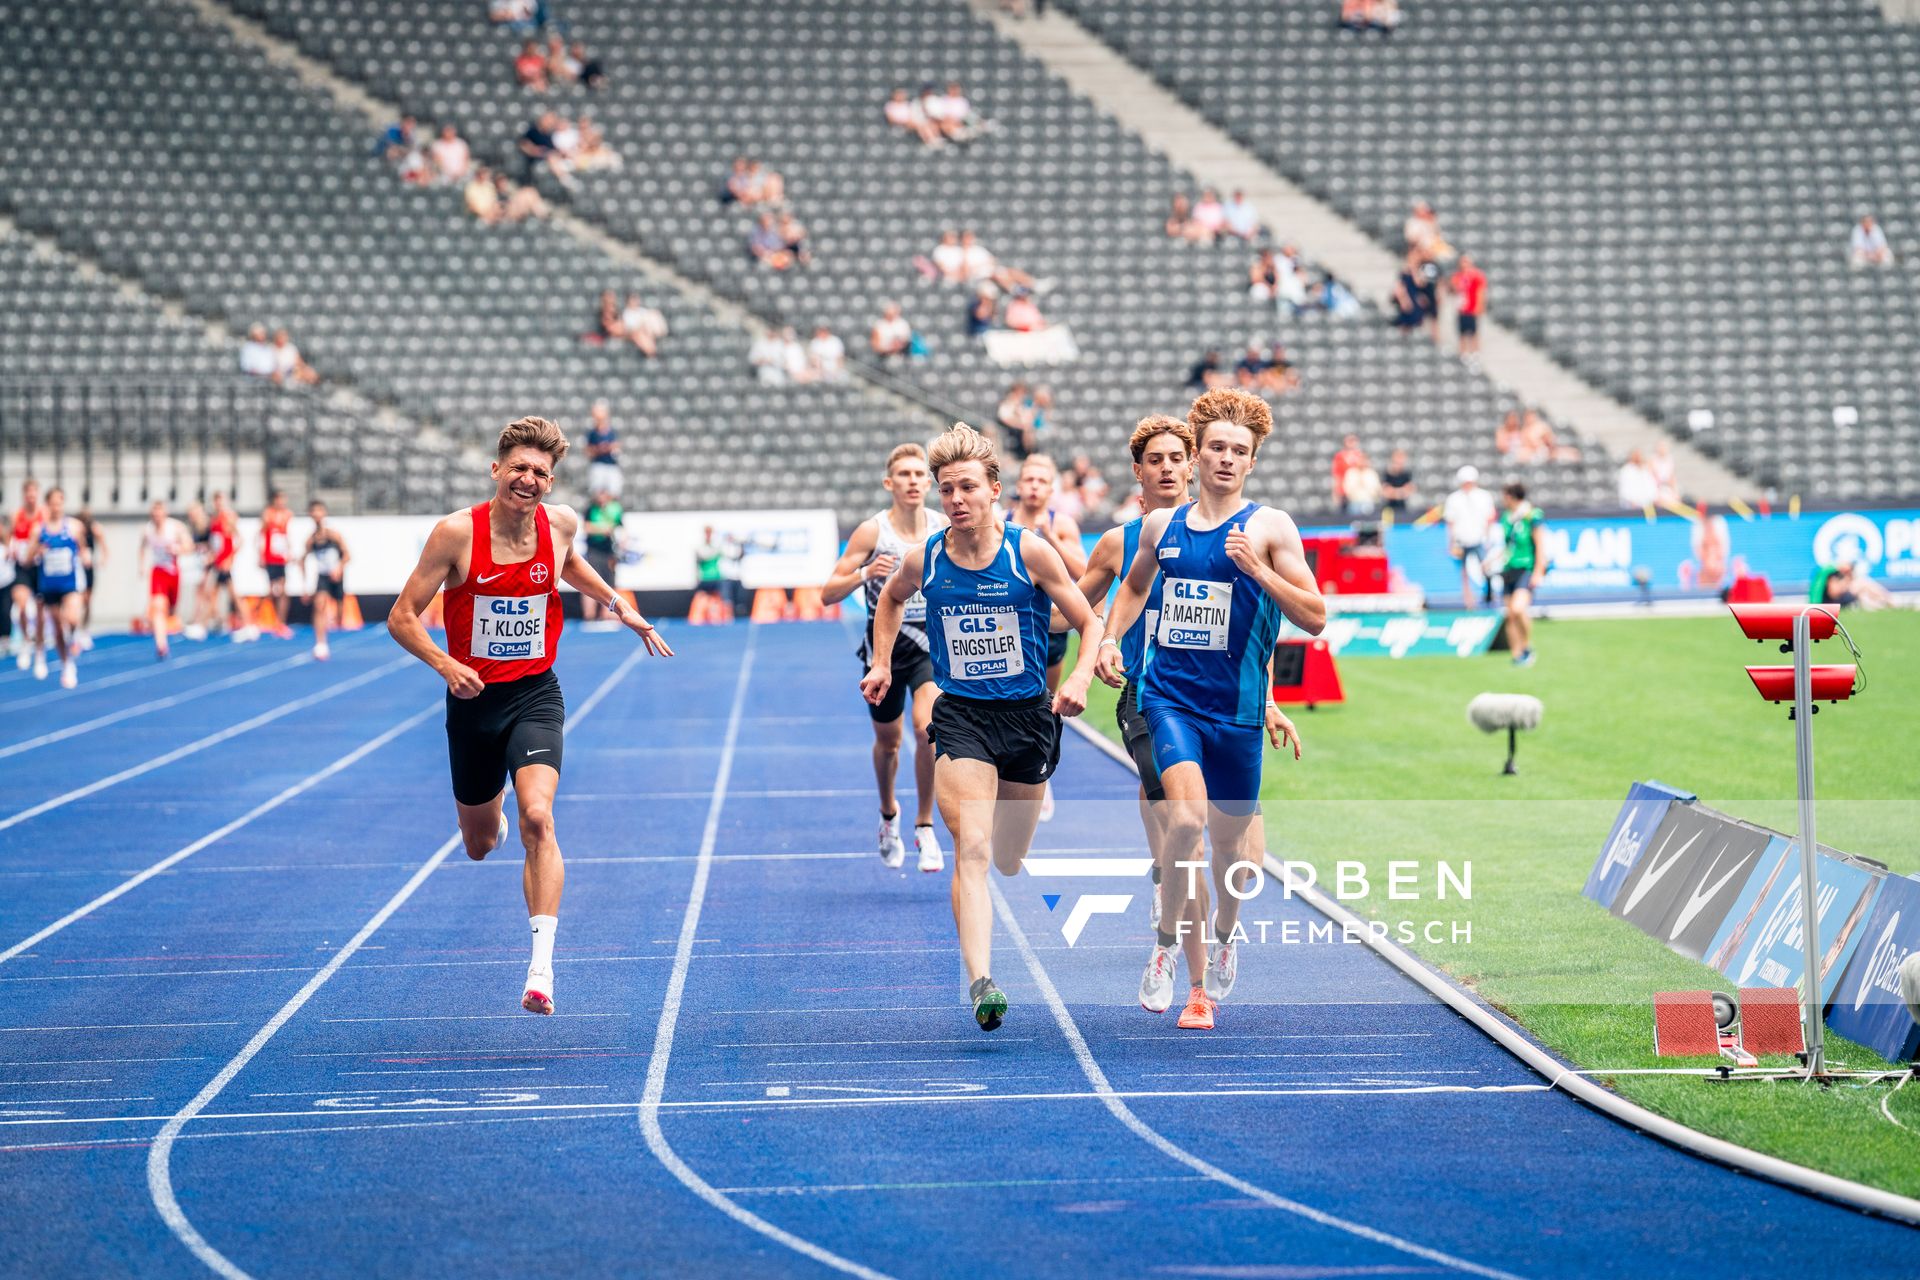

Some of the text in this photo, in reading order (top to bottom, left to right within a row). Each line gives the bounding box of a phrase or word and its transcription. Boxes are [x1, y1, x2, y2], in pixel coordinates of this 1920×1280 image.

[941, 603, 1014, 616] TV Villingen
[1163, 603, 1226, 626] R. MARTIN
[479, 618, 541, 637] T. KLOSE
[1184, 632, 1208, 641] PLAN
[506, 644, 529, 652] PLAN
[952, 635, 1016, 656] ENGSTLER
[981, 661, 1006, 670] PLAN
